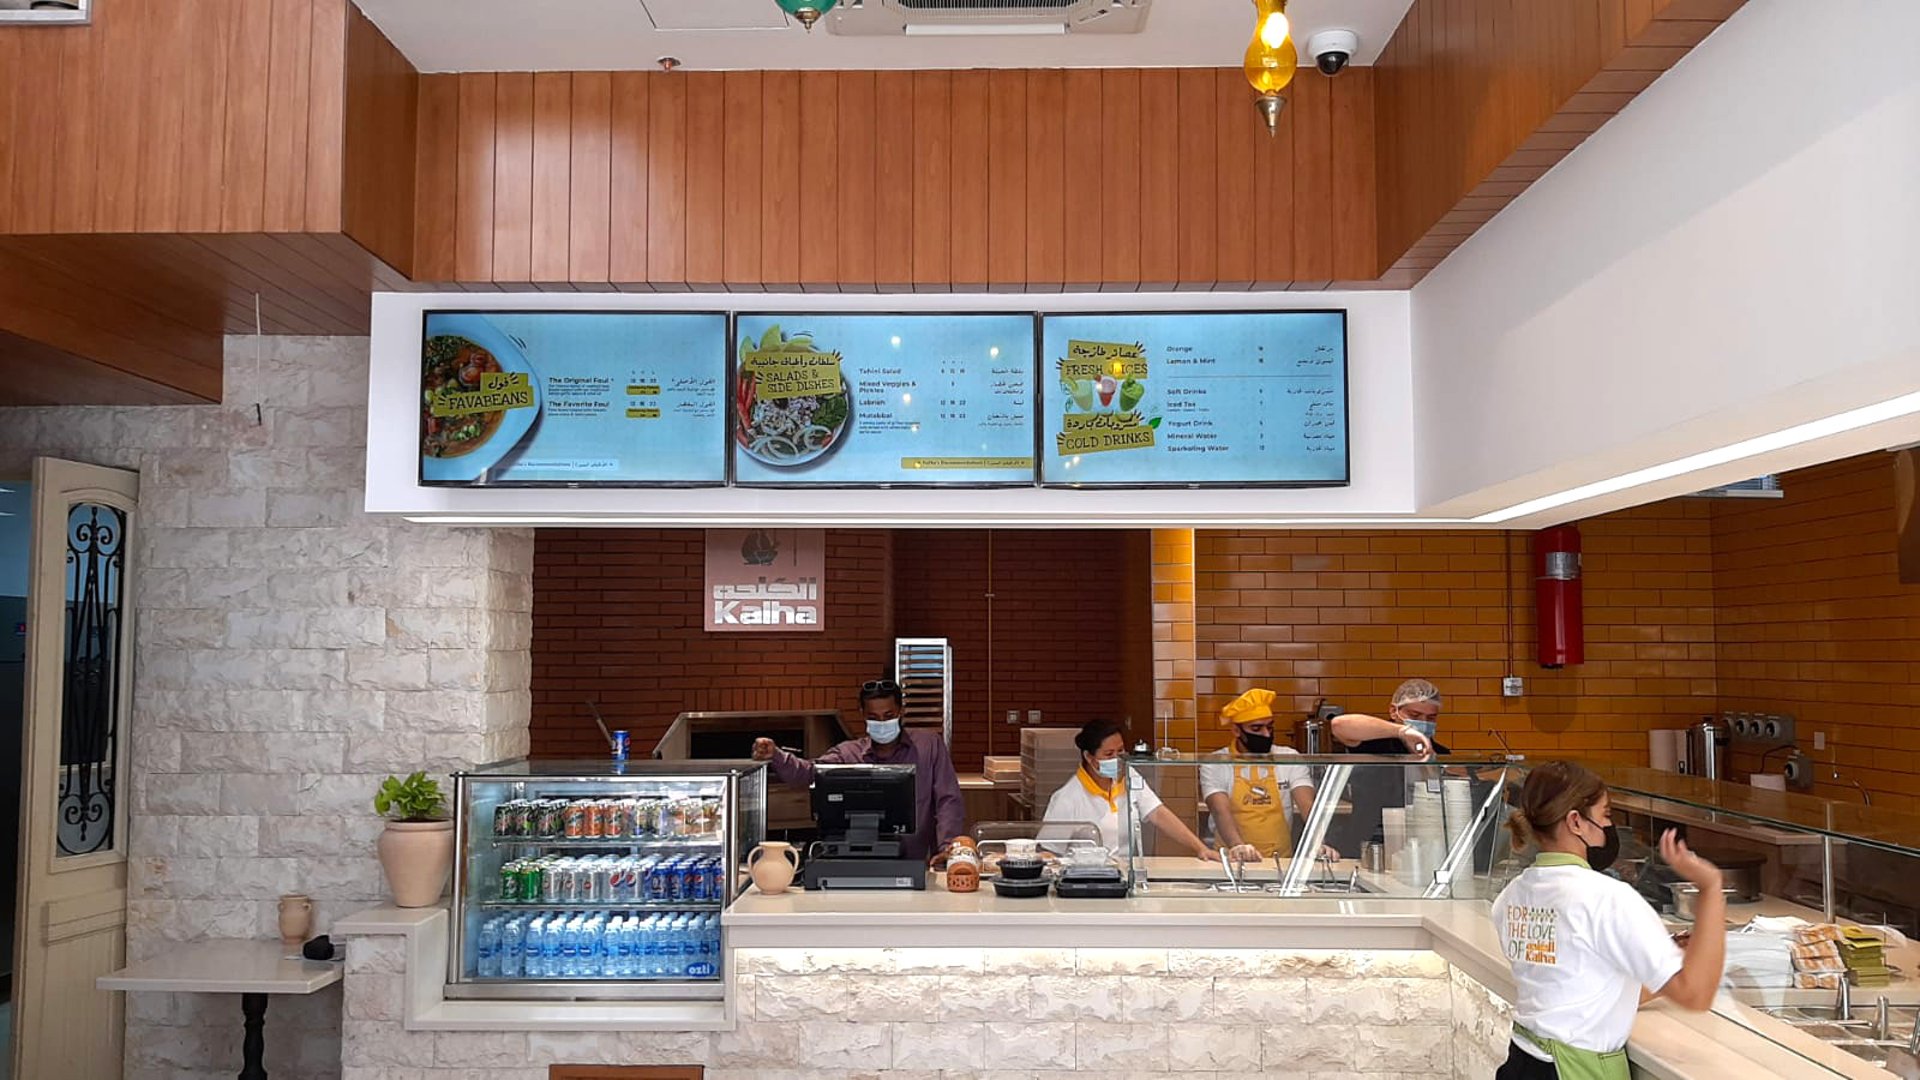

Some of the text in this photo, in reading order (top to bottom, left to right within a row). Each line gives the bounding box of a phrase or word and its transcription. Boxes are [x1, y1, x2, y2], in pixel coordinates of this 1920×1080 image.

[766, 369, 819, 382] SALADS &
[1066, 364, 1104, 375] FRESH
[488, 375, 510, 391] فول
[563, 377, 592, 385] Original
[768, 379, 835, 393] SIDE DISHES
[449, 390, 529, 410] FAVABEANS
[1066, 432, 1150, 449] COLD DRINKS
[714, 601, 817, 625] Kalha
[1507, 905, 1529, 922] FOR
[1508, 922, 1556, 941] THE LOVE
[1507, 940, 1525, 960] OF
[1525, 951, 1556, 965] Kalha
